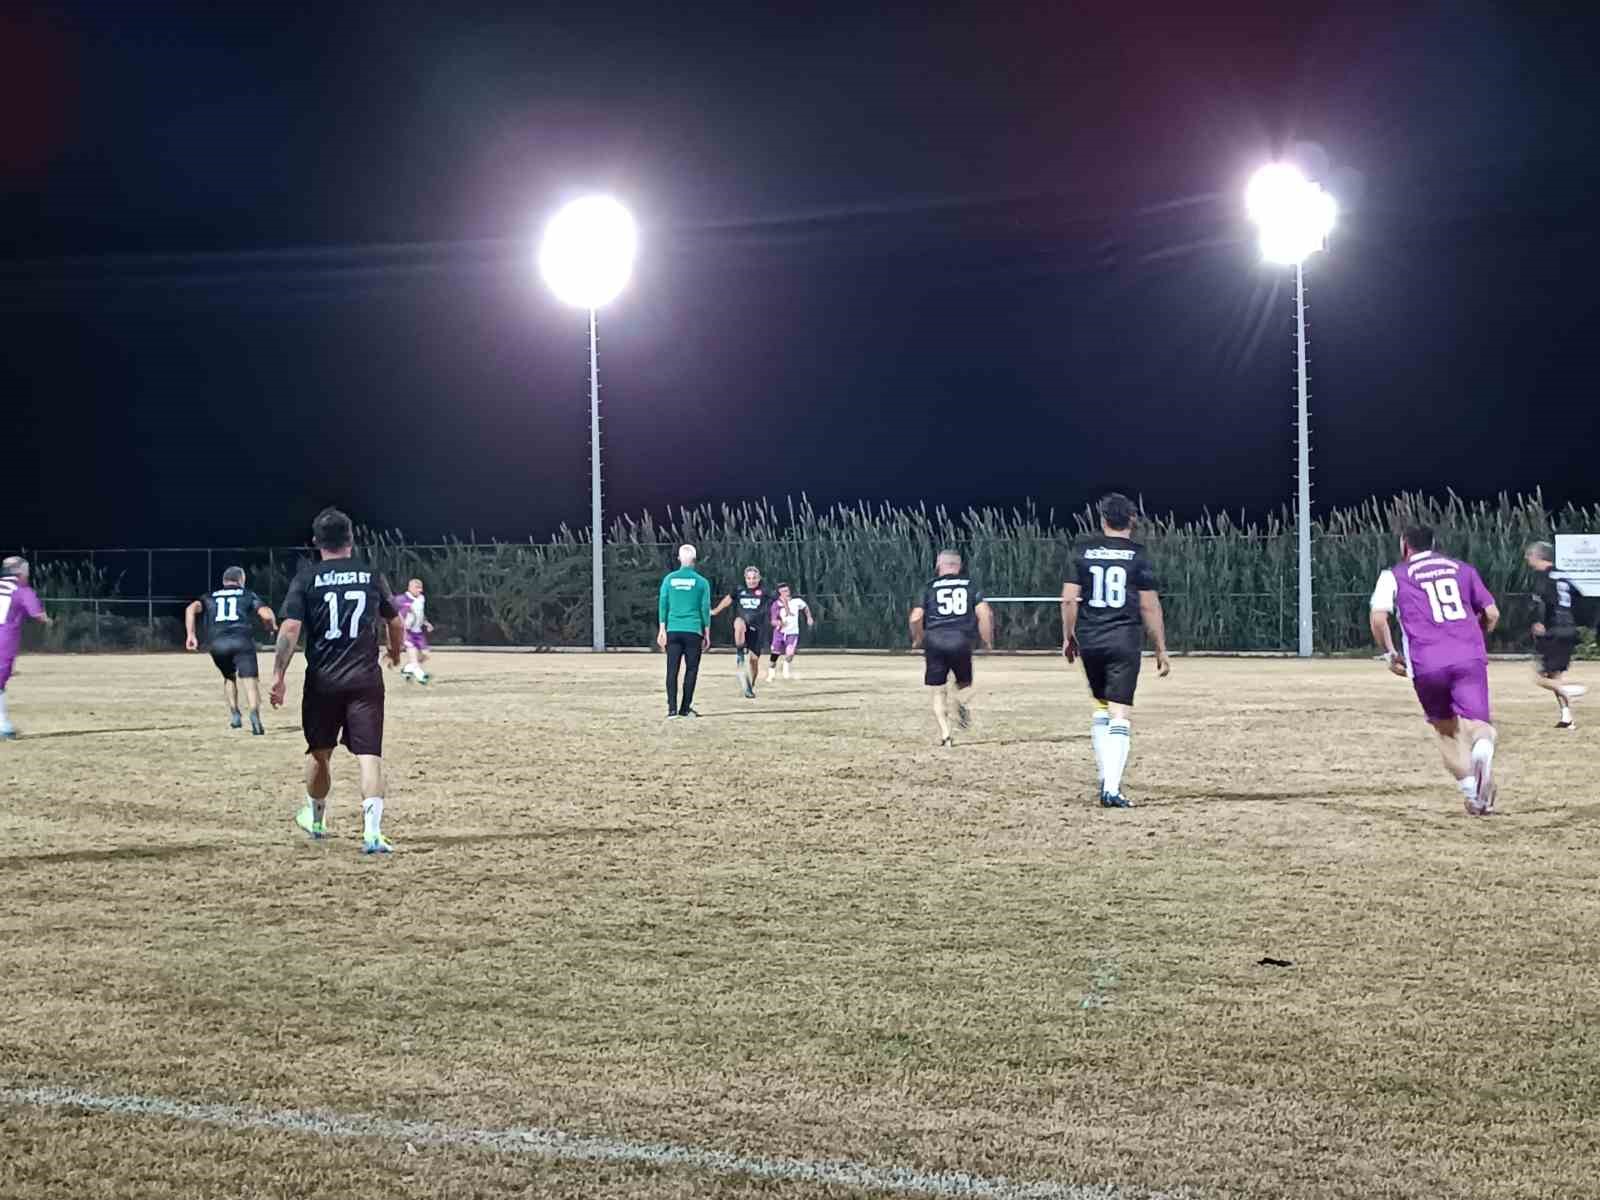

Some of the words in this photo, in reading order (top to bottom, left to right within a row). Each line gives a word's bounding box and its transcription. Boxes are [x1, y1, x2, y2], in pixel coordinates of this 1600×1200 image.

[936, 587, 968, 615] 58
[1088, 565, 1127, 608] 18
[1420, 578, 1467, 623] 19
[215, 596, 240, 621] 11
[323, 590, 367, 640] 17
